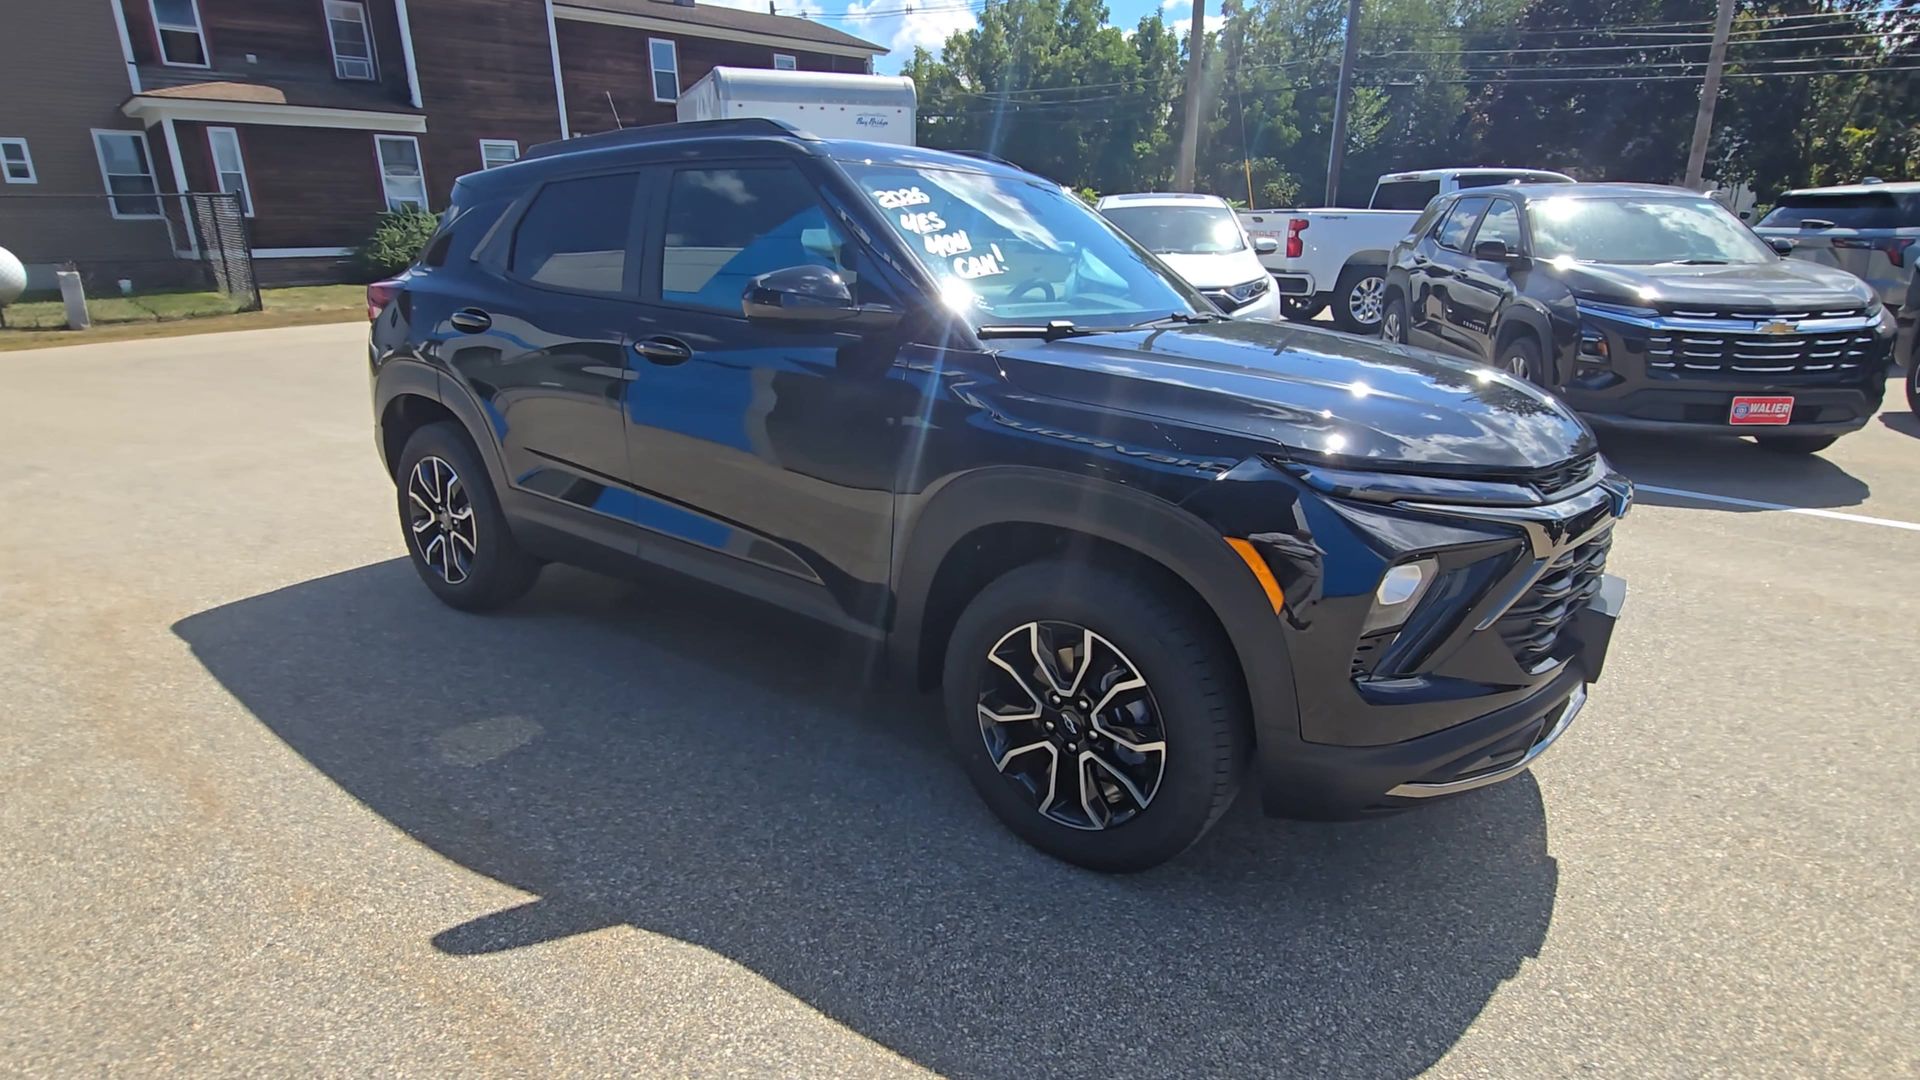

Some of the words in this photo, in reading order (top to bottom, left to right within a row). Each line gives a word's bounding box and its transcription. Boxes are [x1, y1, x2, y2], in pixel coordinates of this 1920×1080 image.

[900, 211, 947, 235] YES
[953, 243, 1010, 279] CAN!
[1750, 403, 1790, 413] WALIER
